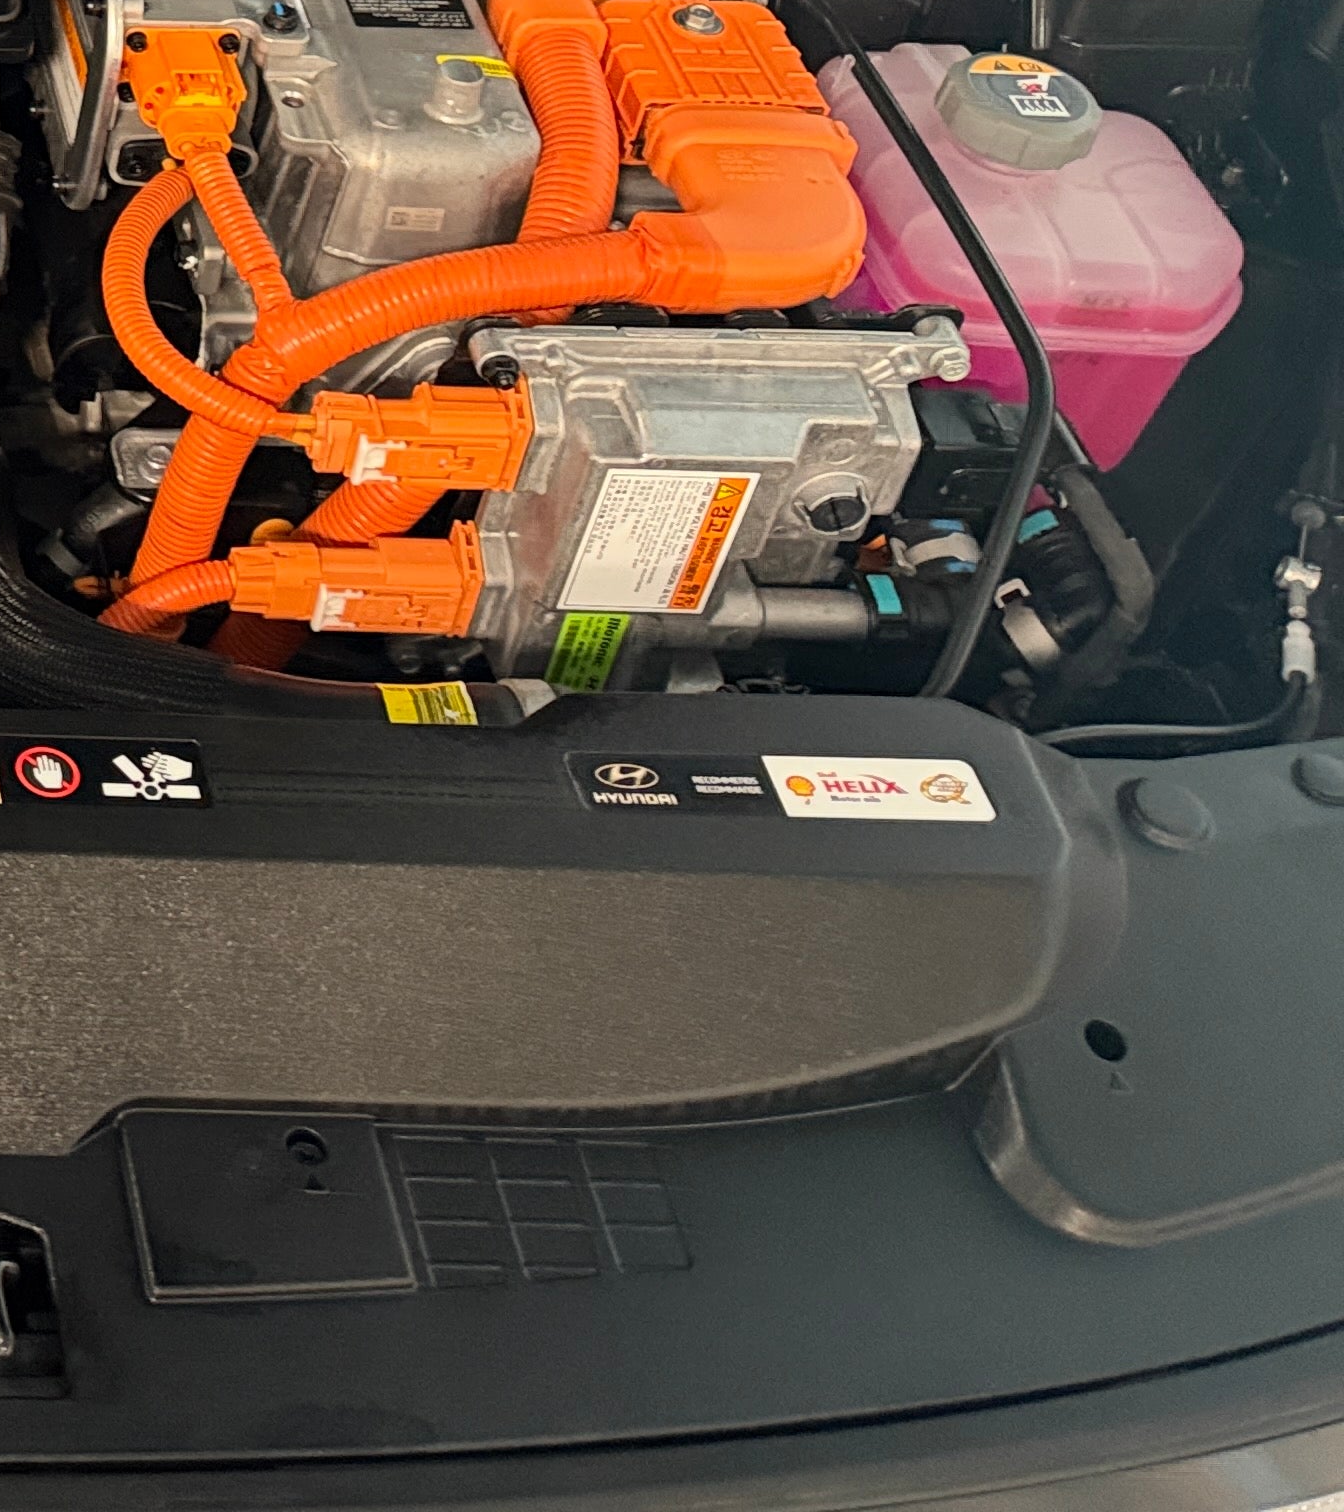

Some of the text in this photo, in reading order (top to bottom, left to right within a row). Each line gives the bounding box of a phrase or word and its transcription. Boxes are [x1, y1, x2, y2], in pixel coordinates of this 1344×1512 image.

[705, 505, 734, 533] 경고
[820, 779, 898, 794] HELIX
[592, 791, 679, 806] HYUNDAI
